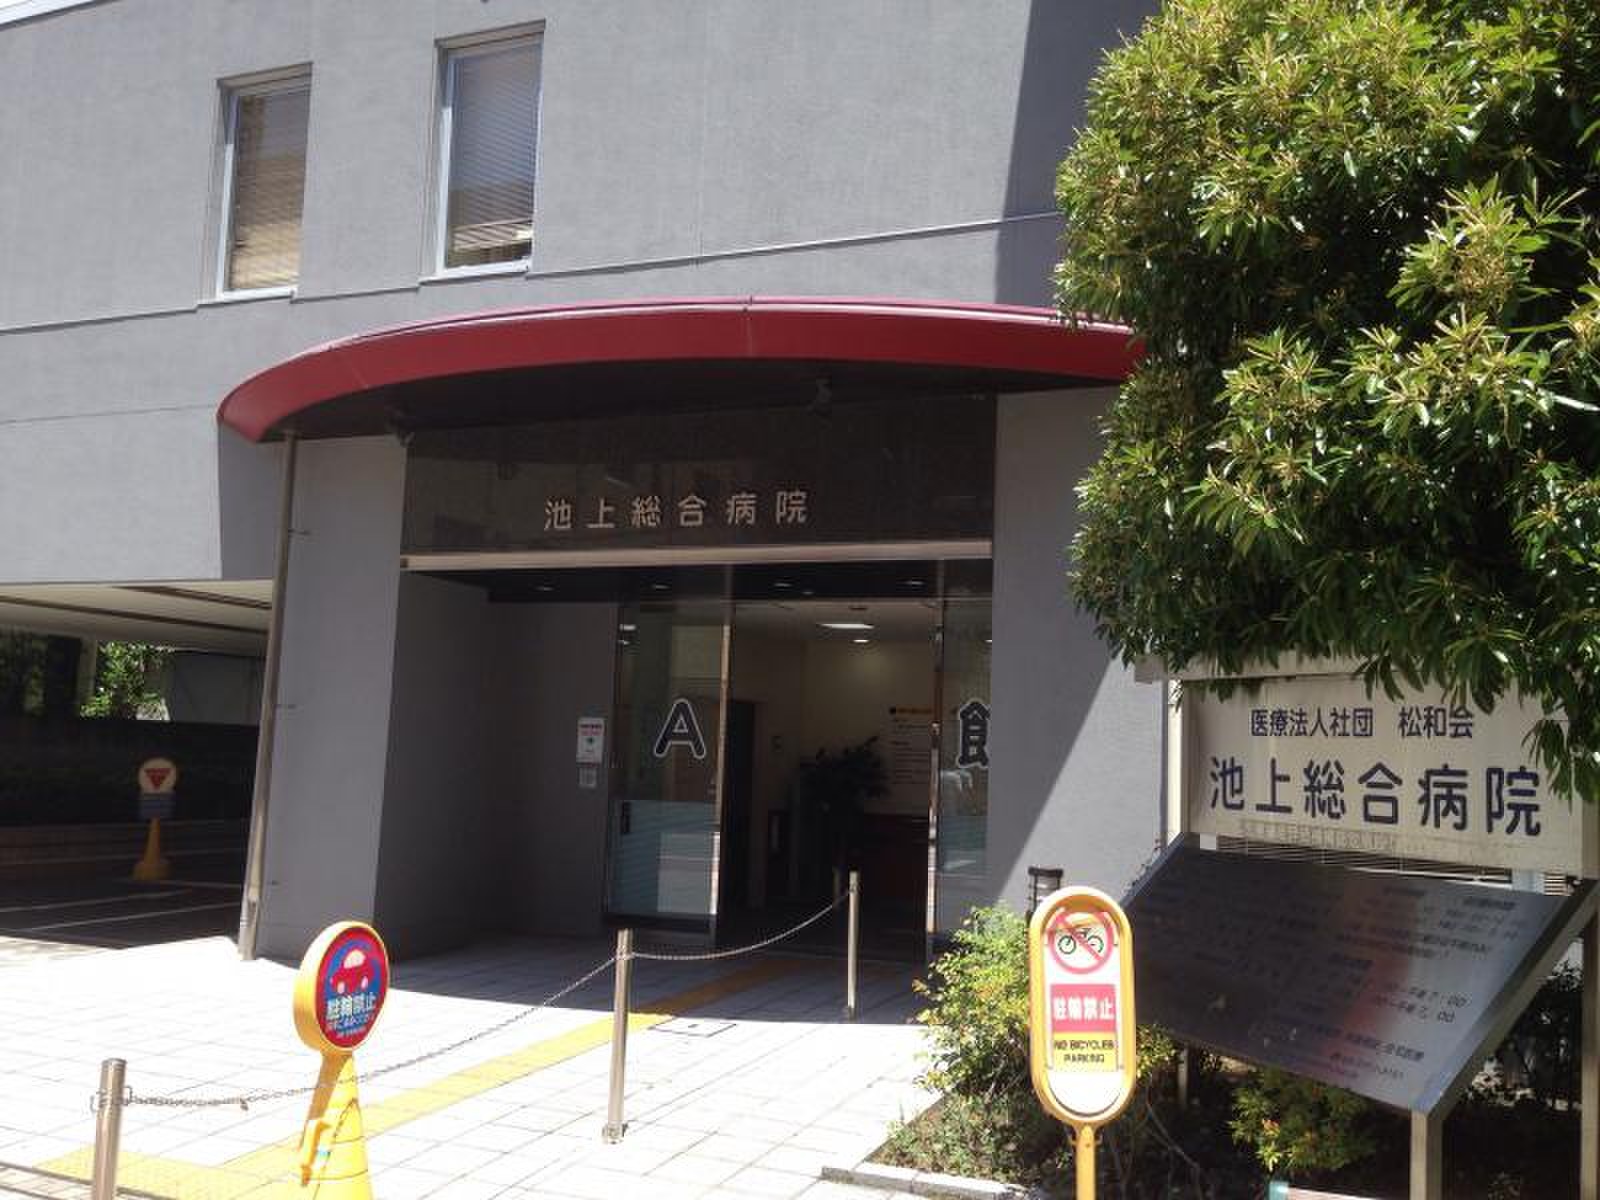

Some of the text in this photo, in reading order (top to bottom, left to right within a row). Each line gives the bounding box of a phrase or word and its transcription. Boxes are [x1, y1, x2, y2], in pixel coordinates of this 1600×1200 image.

[543, 489, 808, 531] 池上総合病院
[654, 697, 707, 760] A
[1250, 705, 1474, 740] 医療法人社団 松和会
[1209, 755, 1542, 838] 池上総合病院
